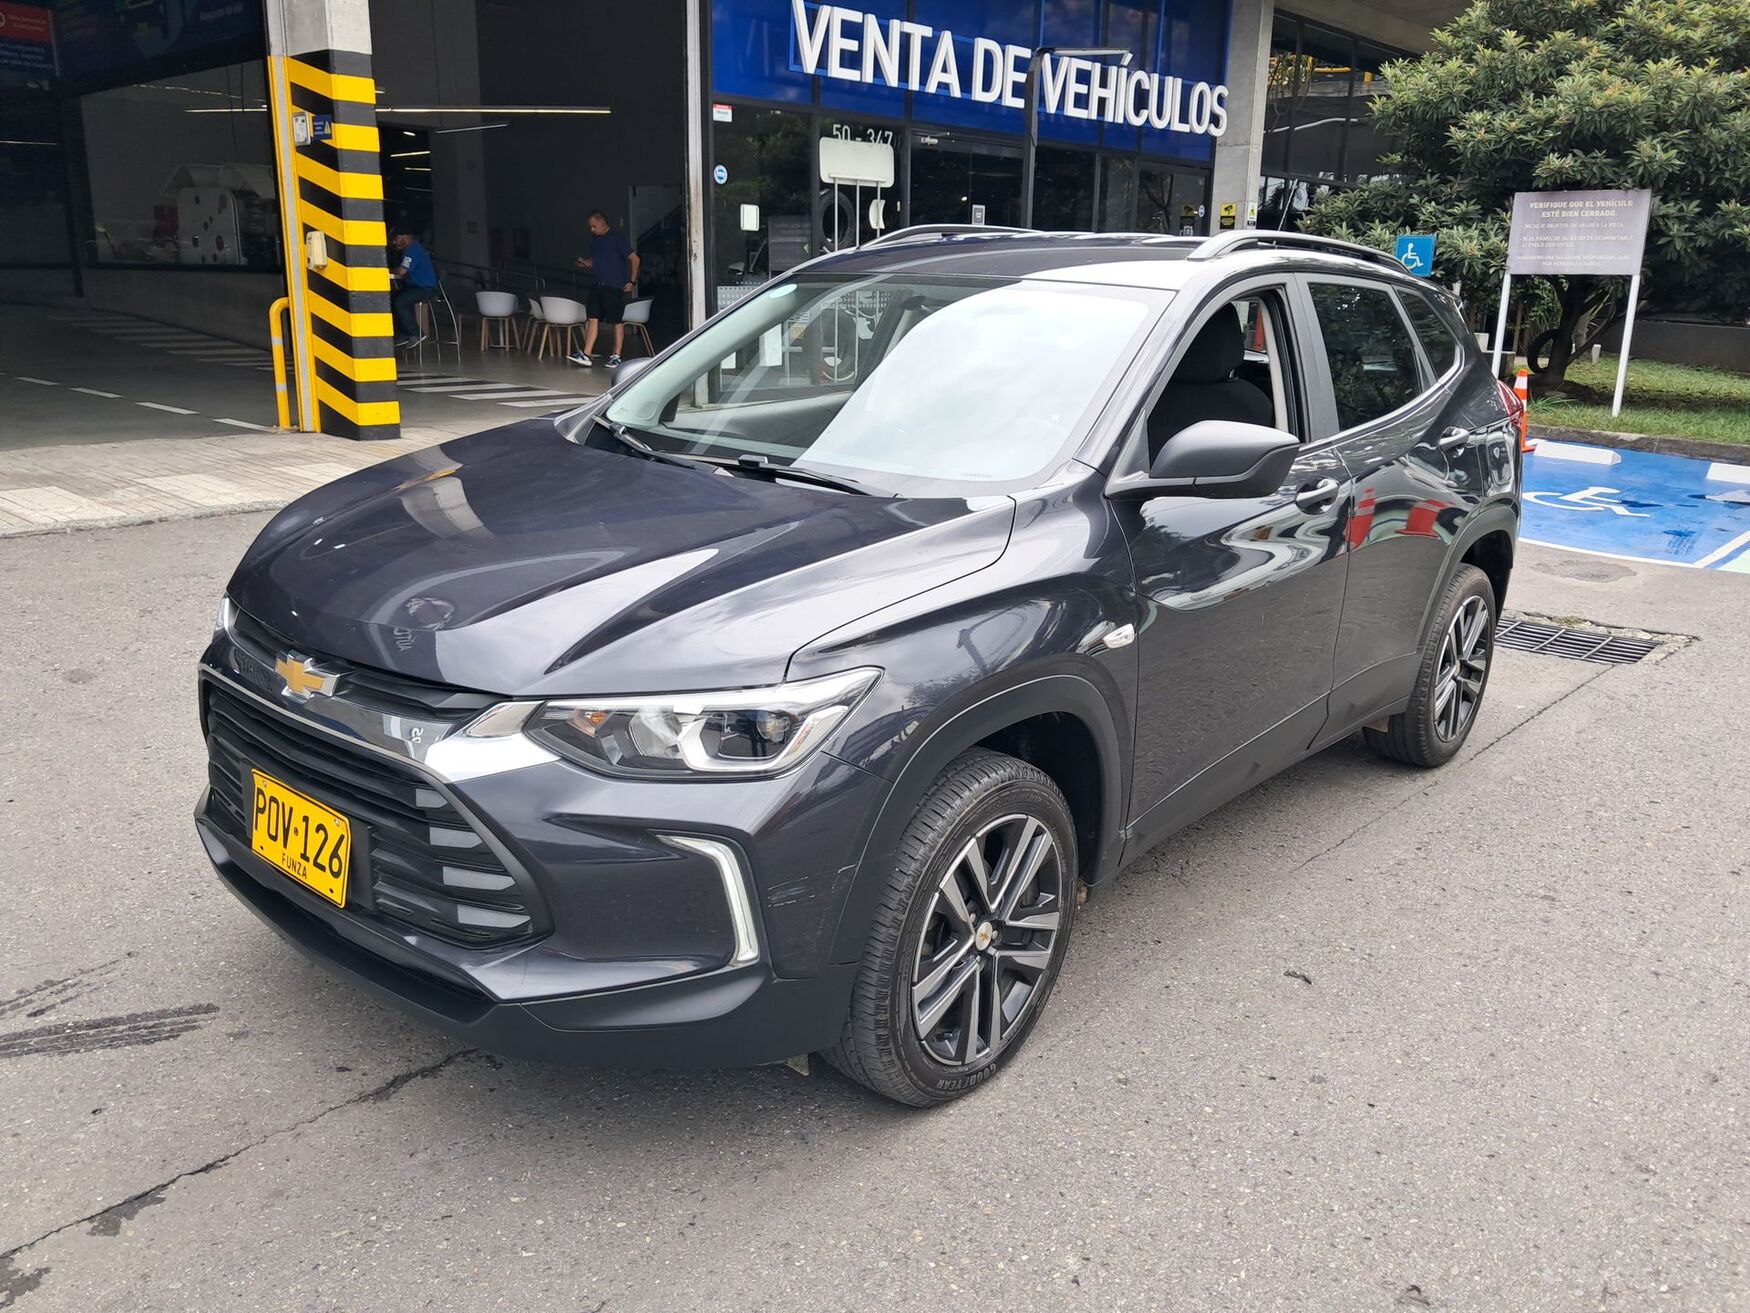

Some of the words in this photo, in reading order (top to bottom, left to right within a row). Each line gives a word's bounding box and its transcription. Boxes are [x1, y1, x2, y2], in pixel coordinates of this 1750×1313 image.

[792, 0, 961, 98] VENTA
[972, 37, 1032, 109] DE
[1041, 53, 1230, 137] VEHÍCULOS
[833, 124, 851, 141] 50
[866, 128, 893, 145] 347
[1529, 200, 1567, 209] VERIFIQUE
[1569, 200, 1584, 208] QUE
[1585, 200, 1595, 208] EL
[1597, 198, 1634, 207] VEHÍCULO
[1542, 209, 1560, 218] ESTÉ
[256, 786, 294, 850] POV
[300, 815, 345, 879] 126
[281, 852, 308, 880] FUNZA
